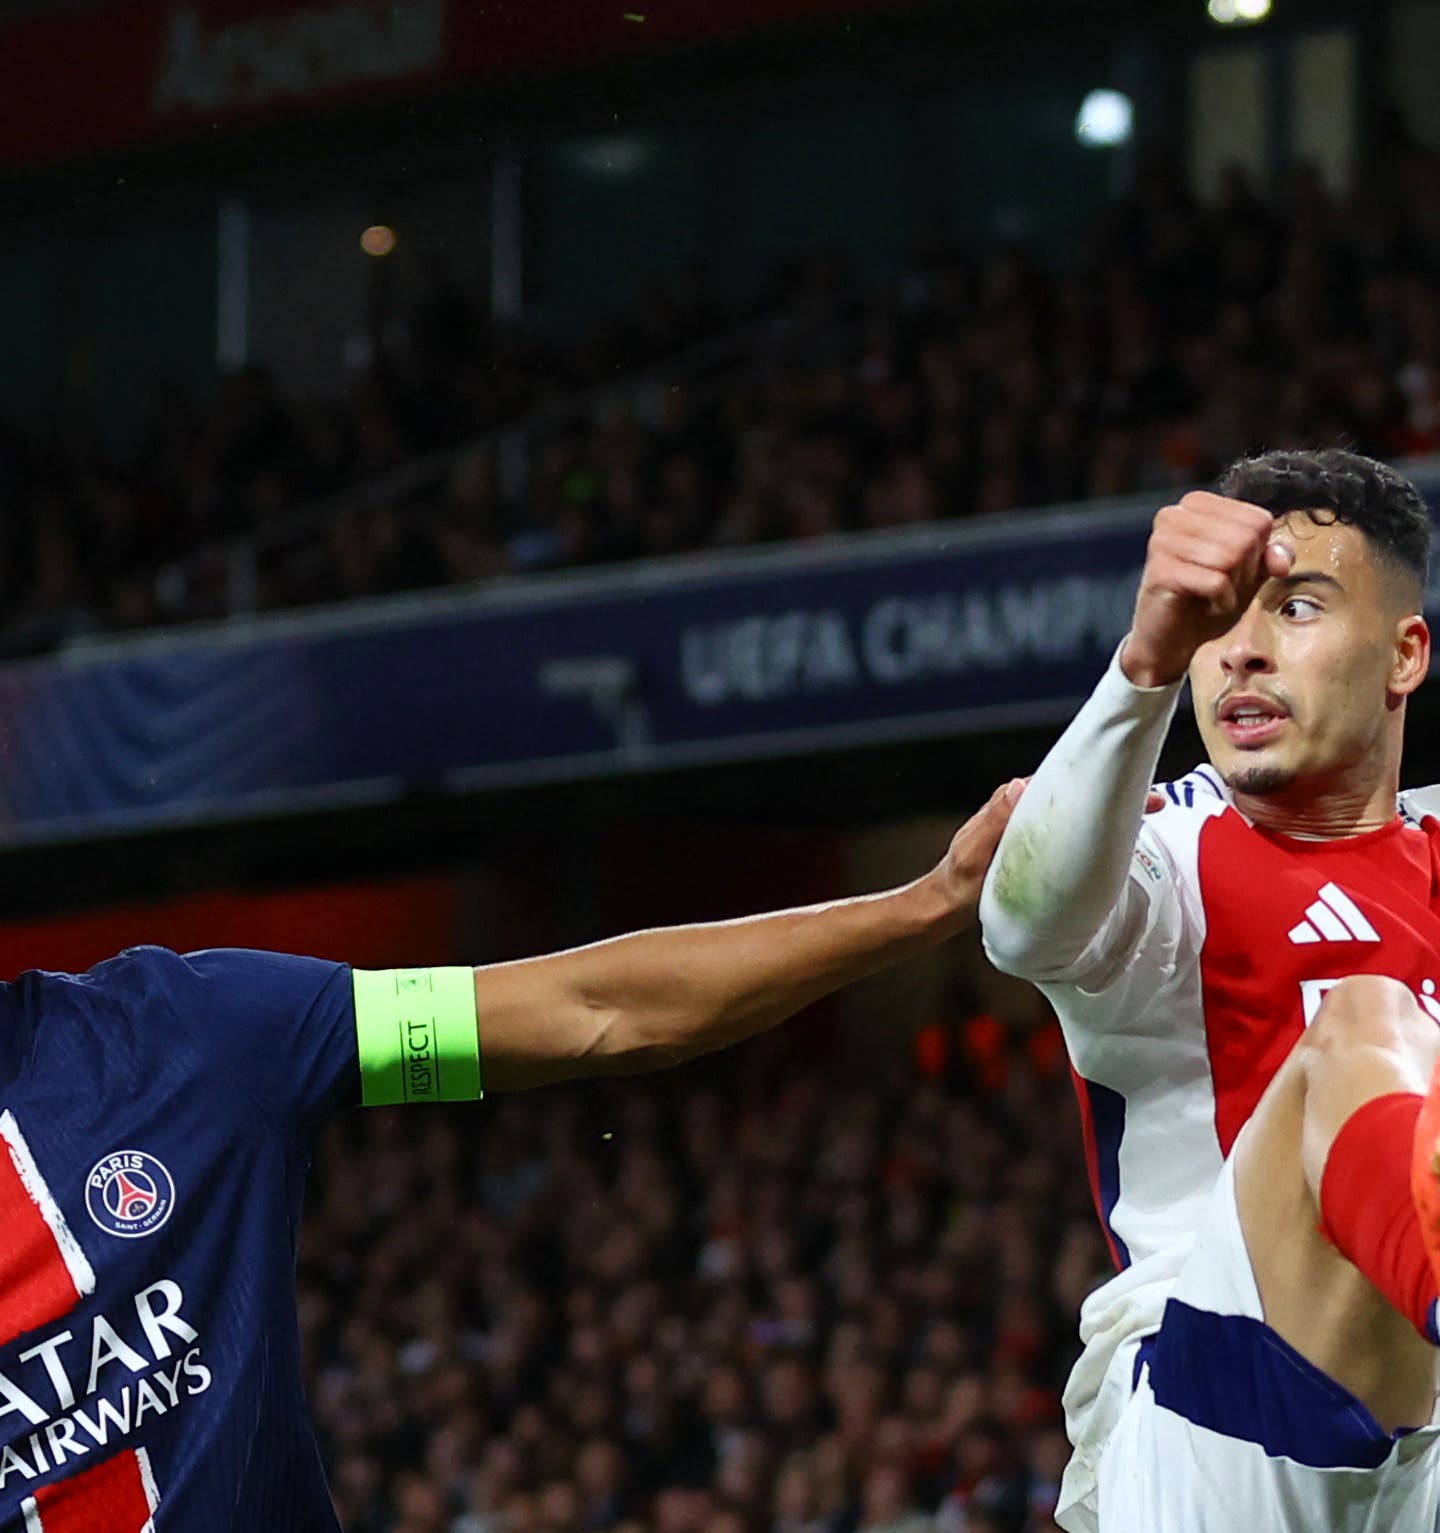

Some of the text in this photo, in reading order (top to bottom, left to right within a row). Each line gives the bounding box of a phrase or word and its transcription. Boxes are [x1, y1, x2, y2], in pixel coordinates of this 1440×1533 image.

[679, 606, 856, 706] UEFA
[862, 572, 1148, 685] CHAMPI
[90, 1154, 144, 1189] PARIS
